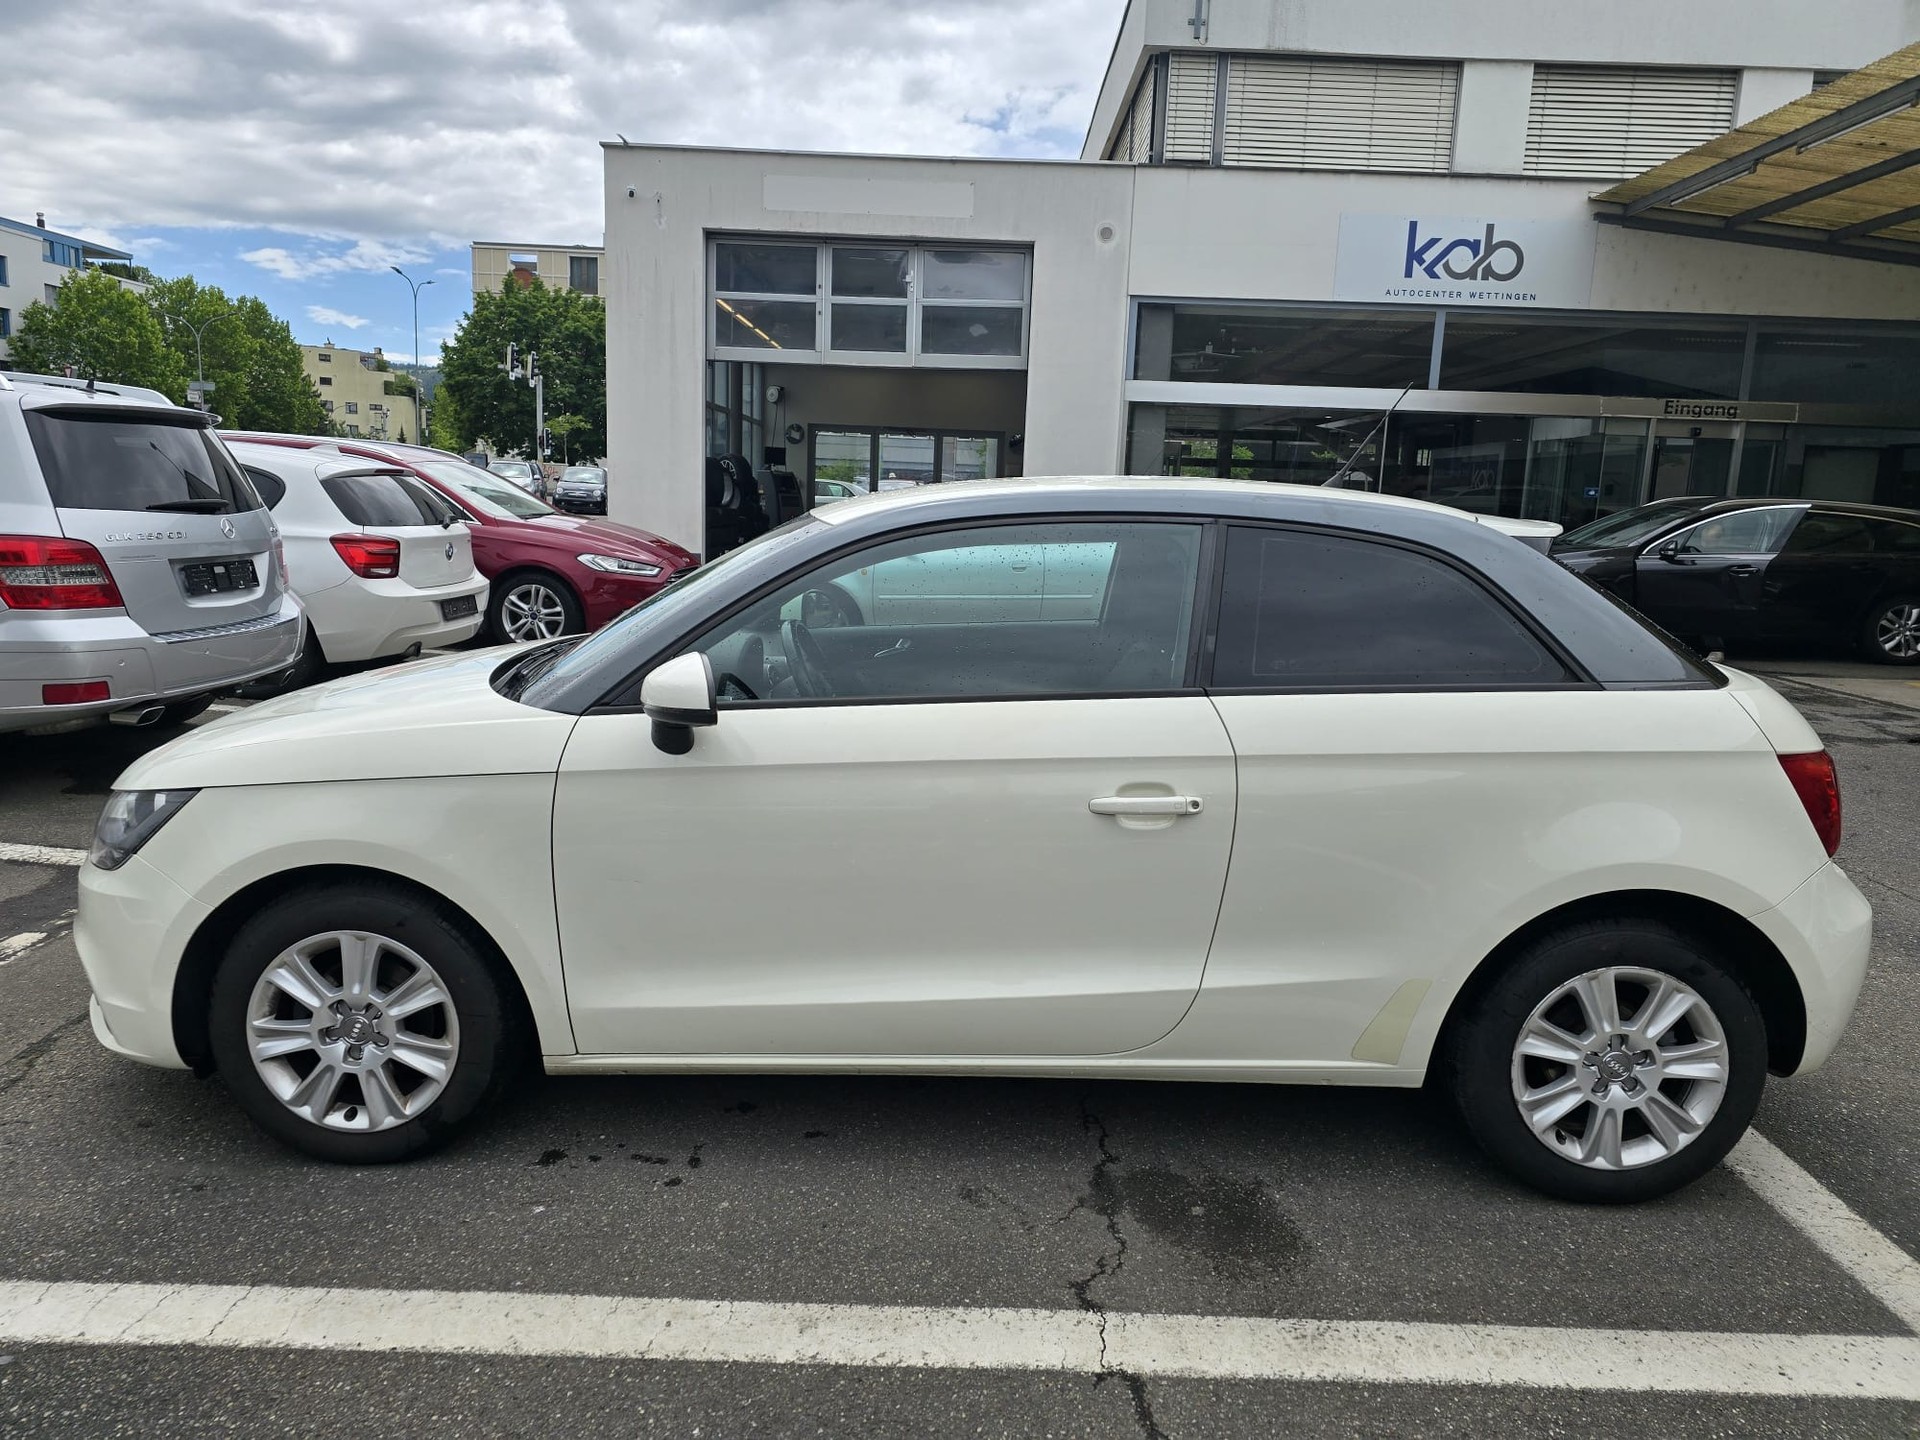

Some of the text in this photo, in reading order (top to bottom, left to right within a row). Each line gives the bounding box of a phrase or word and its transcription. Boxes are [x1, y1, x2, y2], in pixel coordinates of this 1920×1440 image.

[1404, 220, 1525, 281] kab
[1385, 288, 1537, 301] AUTOCENTER WETTINGEN
[1663, 399, 1738, 419] Eingang
[105, 532, 133, 542] GLK
[167, 531, 187, 540] CDI
